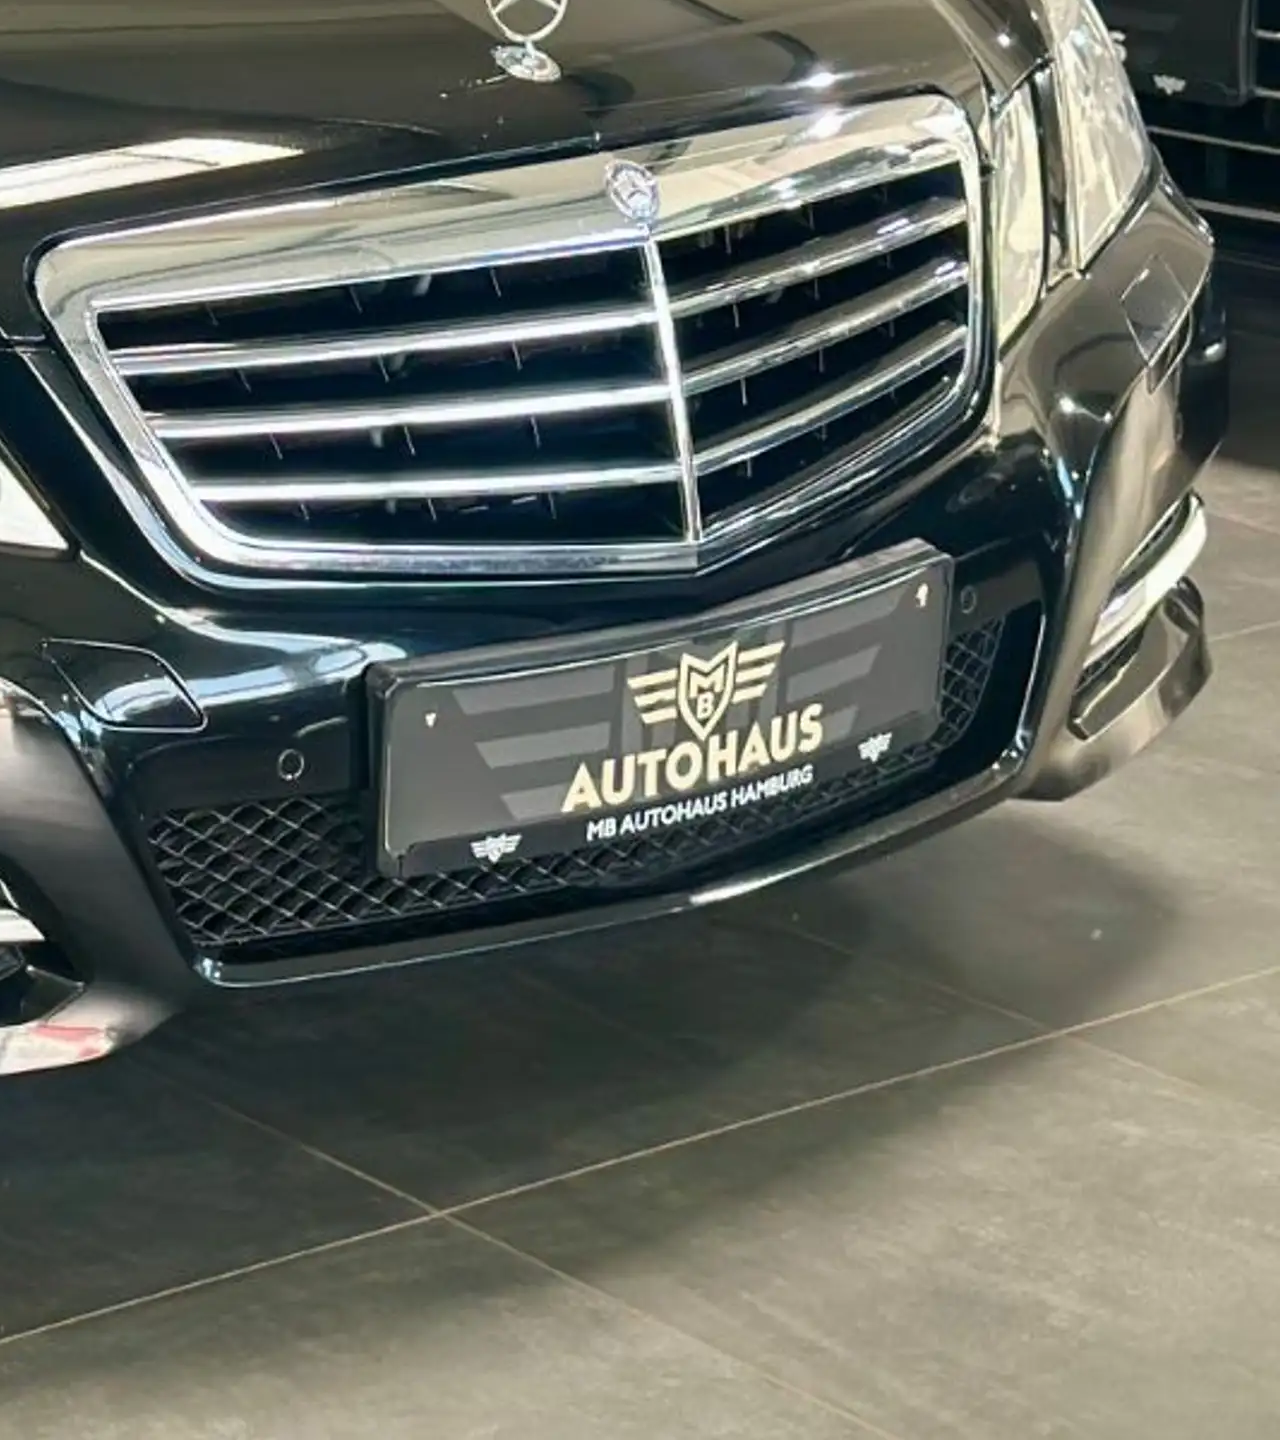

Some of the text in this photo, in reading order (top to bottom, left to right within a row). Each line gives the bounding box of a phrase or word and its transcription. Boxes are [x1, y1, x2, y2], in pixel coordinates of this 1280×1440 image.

[559, 702, 824, 813] AUTOHAUS
[586, 764, 814, 842] MB AUTOHAUS HAMBURG
